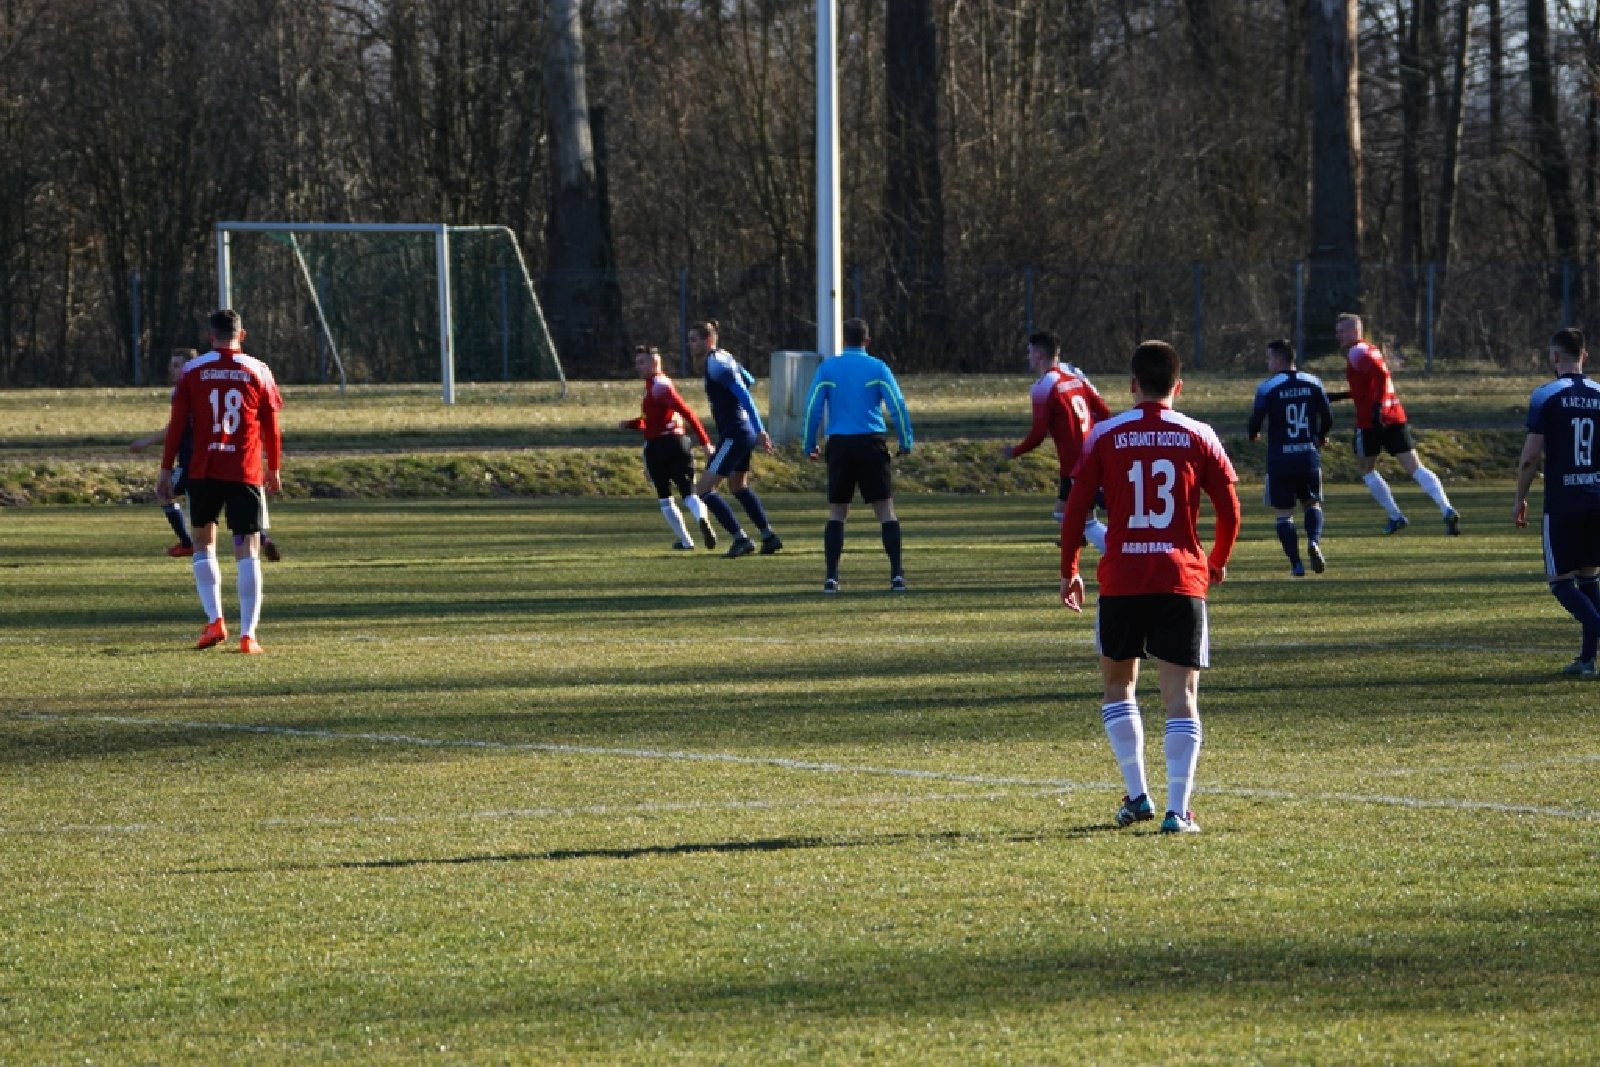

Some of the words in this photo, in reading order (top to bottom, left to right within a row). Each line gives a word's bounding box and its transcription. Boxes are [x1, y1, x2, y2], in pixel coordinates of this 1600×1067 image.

[209, 387, 242, 435] 18
[1071, 395, 1089, 433] 9
[1286, 402, 1309, 438] 94
[1561, 395, 1600, 409] KACZAW
[1113, 433, 1127, 449] LKS
[1128, 431, 1156, 447] GRANIT
[1571, 417, 1594, 467] 19
[1127, 458, 1176, 529] 13
[1121, 541, 1148, 554] AGRO
